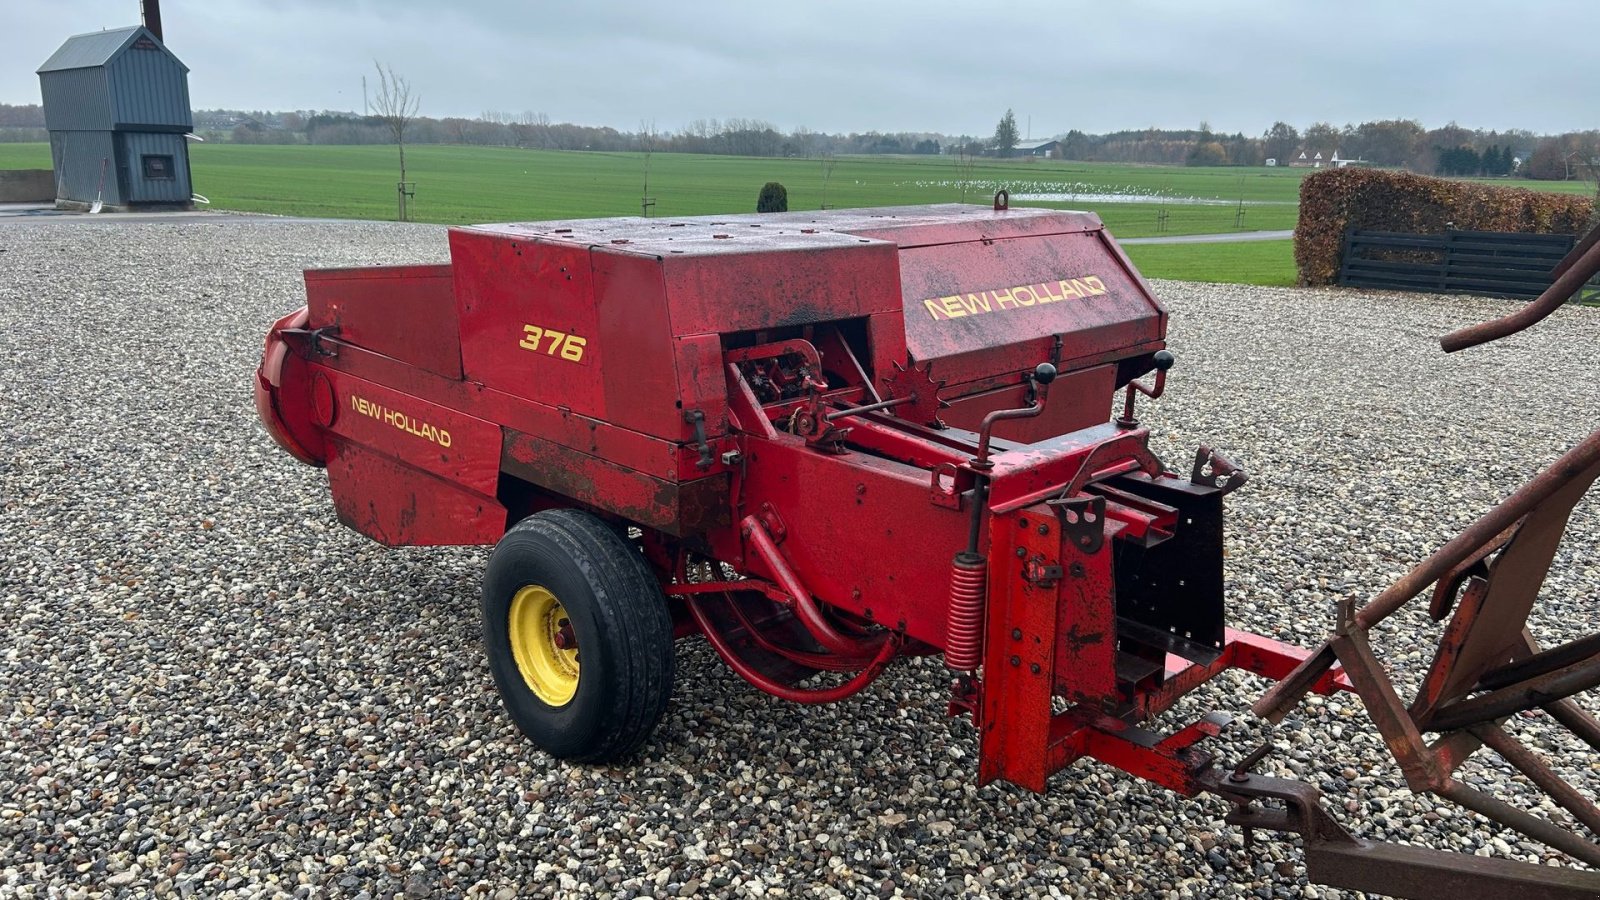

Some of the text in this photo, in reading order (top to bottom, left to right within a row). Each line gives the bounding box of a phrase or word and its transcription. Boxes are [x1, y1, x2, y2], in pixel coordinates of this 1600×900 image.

[924, 276, 1107, 320] NEW HOLLAND
[520, 324, 587, 362] 376
[352, 395, 452, 448] NEW HOLLAND
